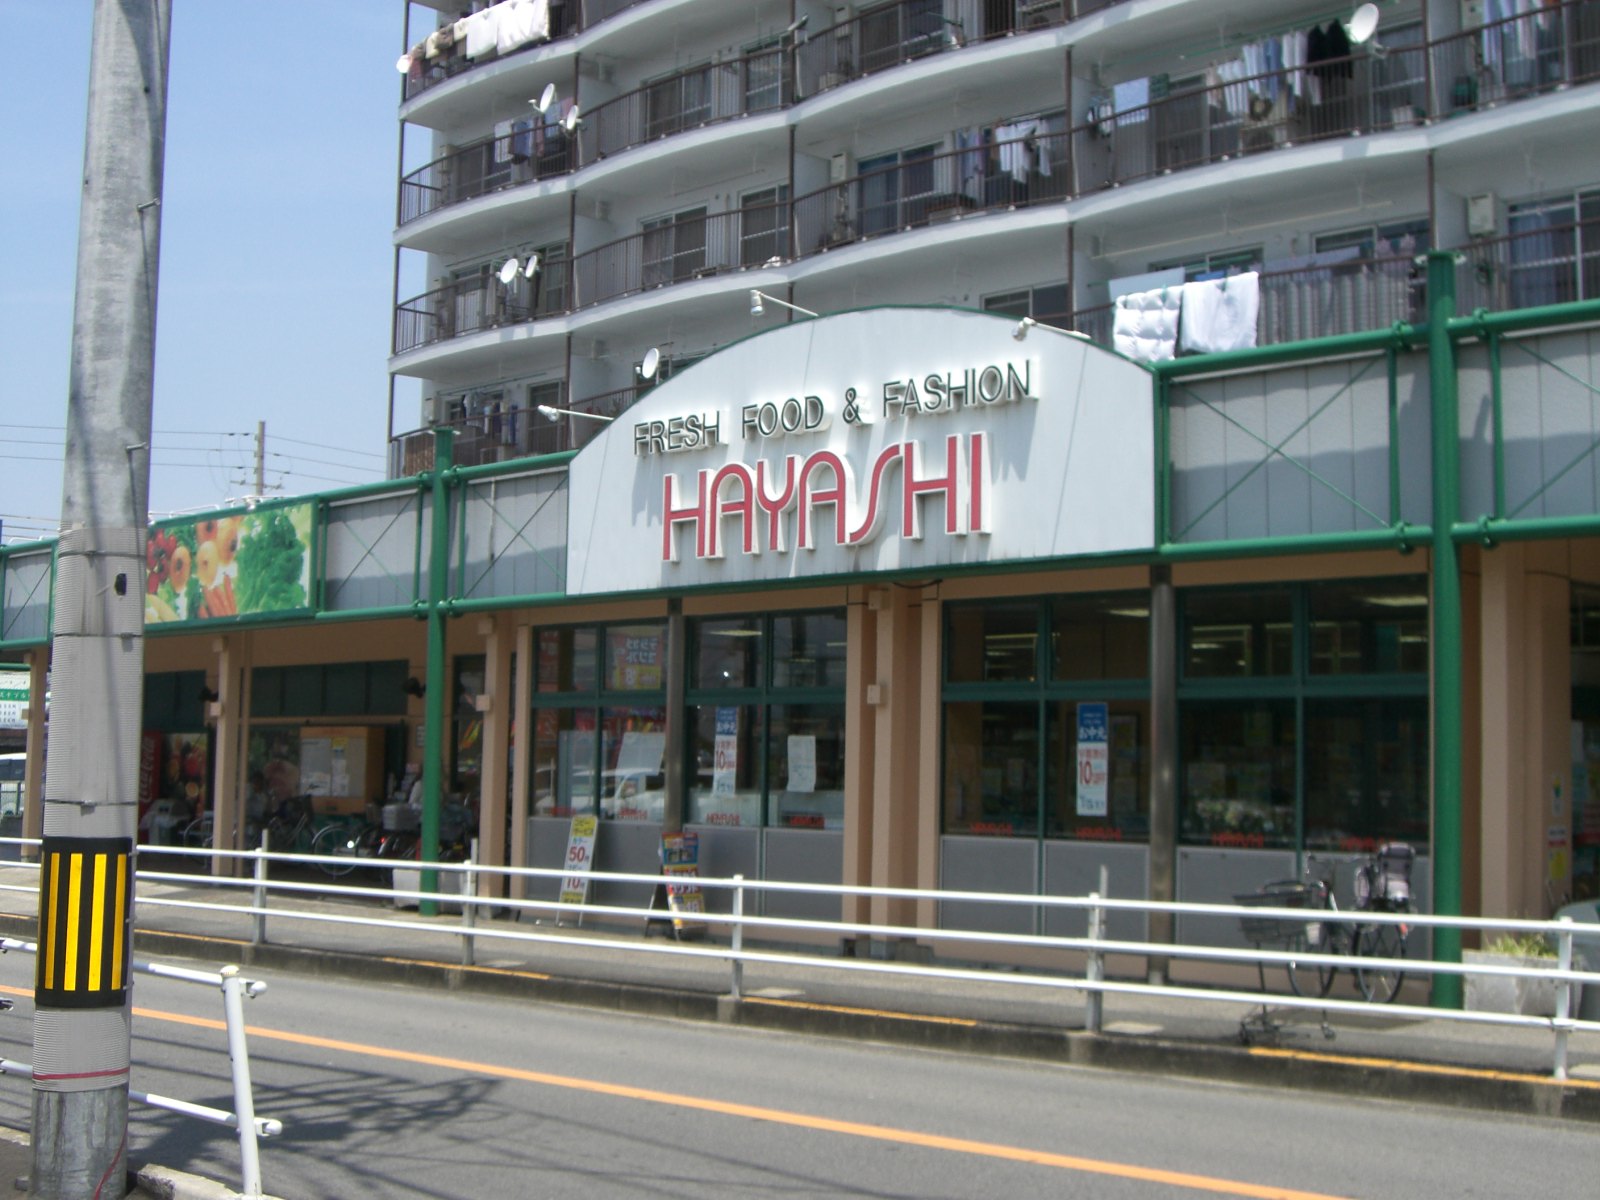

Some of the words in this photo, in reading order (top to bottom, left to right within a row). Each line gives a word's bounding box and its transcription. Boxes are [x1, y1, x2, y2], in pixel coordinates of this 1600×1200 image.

[633, 409, 722, 457] FRESH
[741, 394, 828, 440] FOOD
[841, 387, 865, 425] &
[881, 358, 1033, 418] FASHION
[662, 431, 990, 562] HAYASHI
